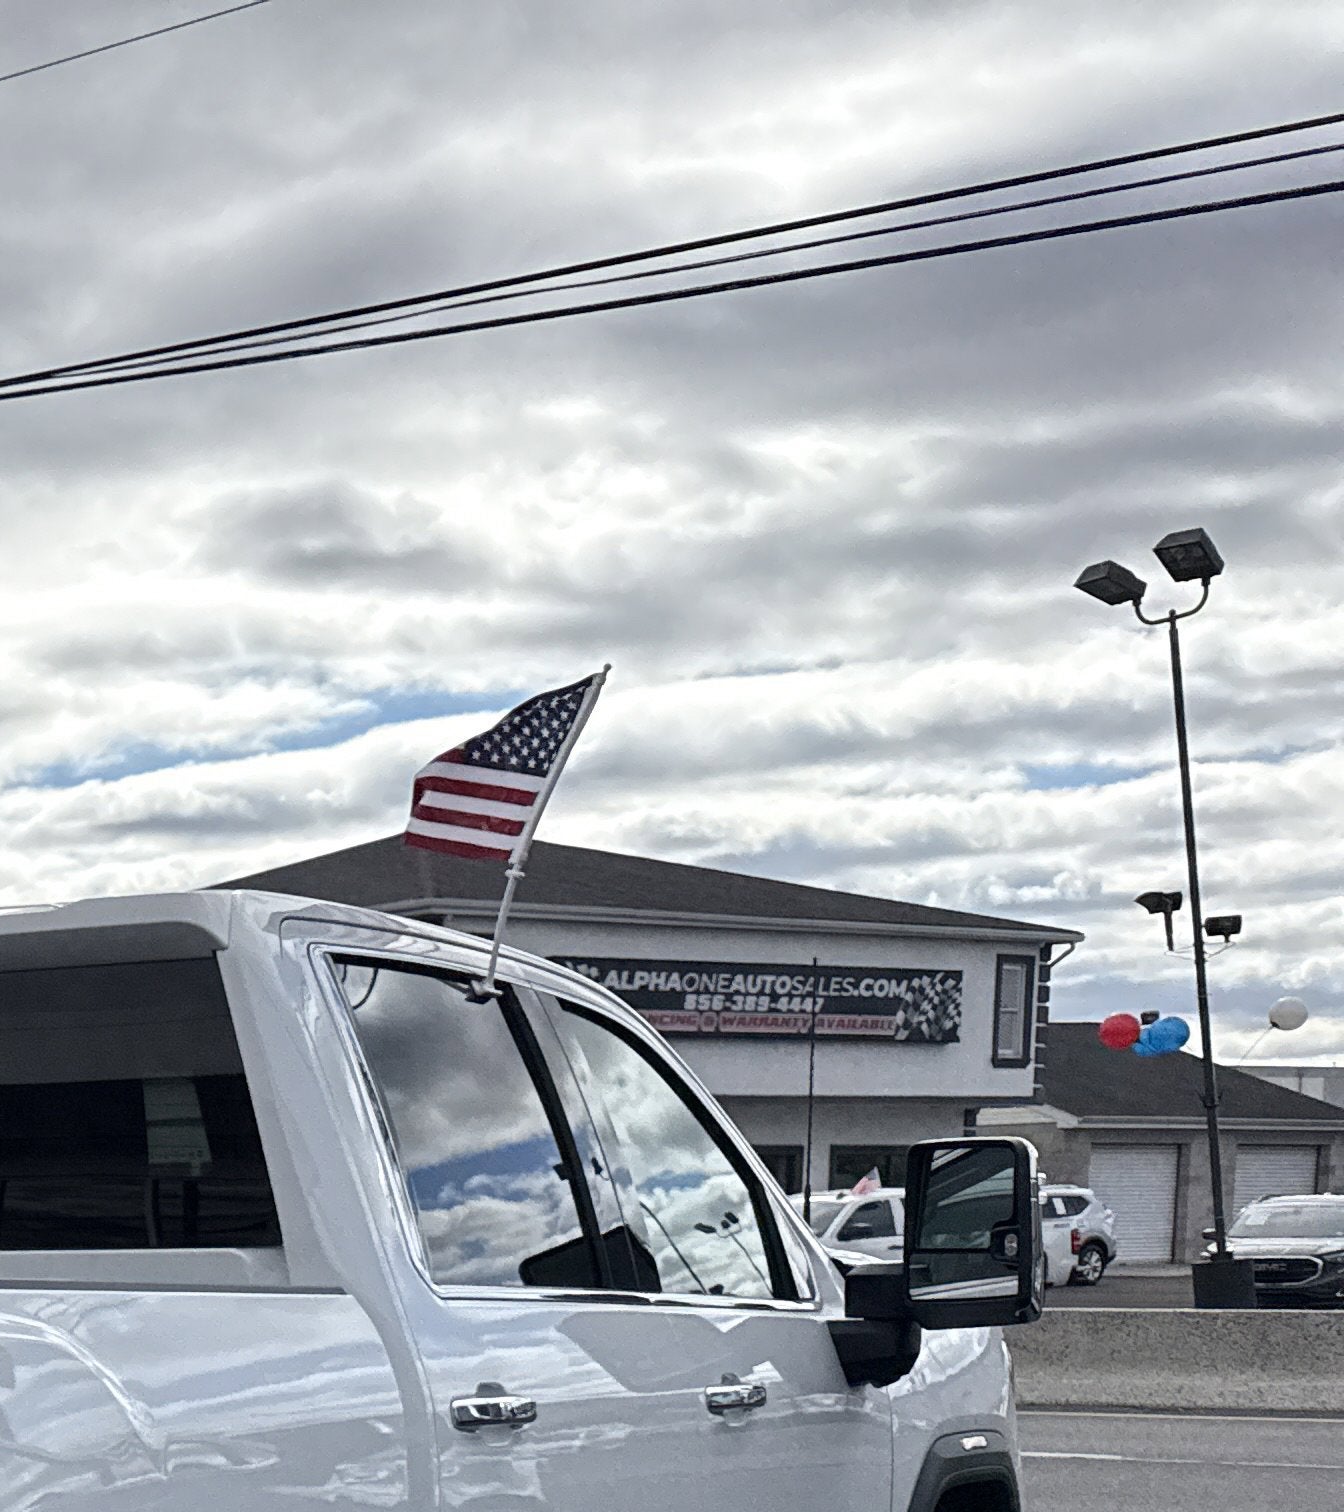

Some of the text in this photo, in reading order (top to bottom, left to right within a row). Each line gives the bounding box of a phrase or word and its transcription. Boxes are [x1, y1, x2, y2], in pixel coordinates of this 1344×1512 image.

[602, 969, 909, 998] ALPHAONEAUTOSALES.COM
[683, 993, 825, 1013] 856-389-4447
[814, 1015, 895, 1031] AVAILABLE
